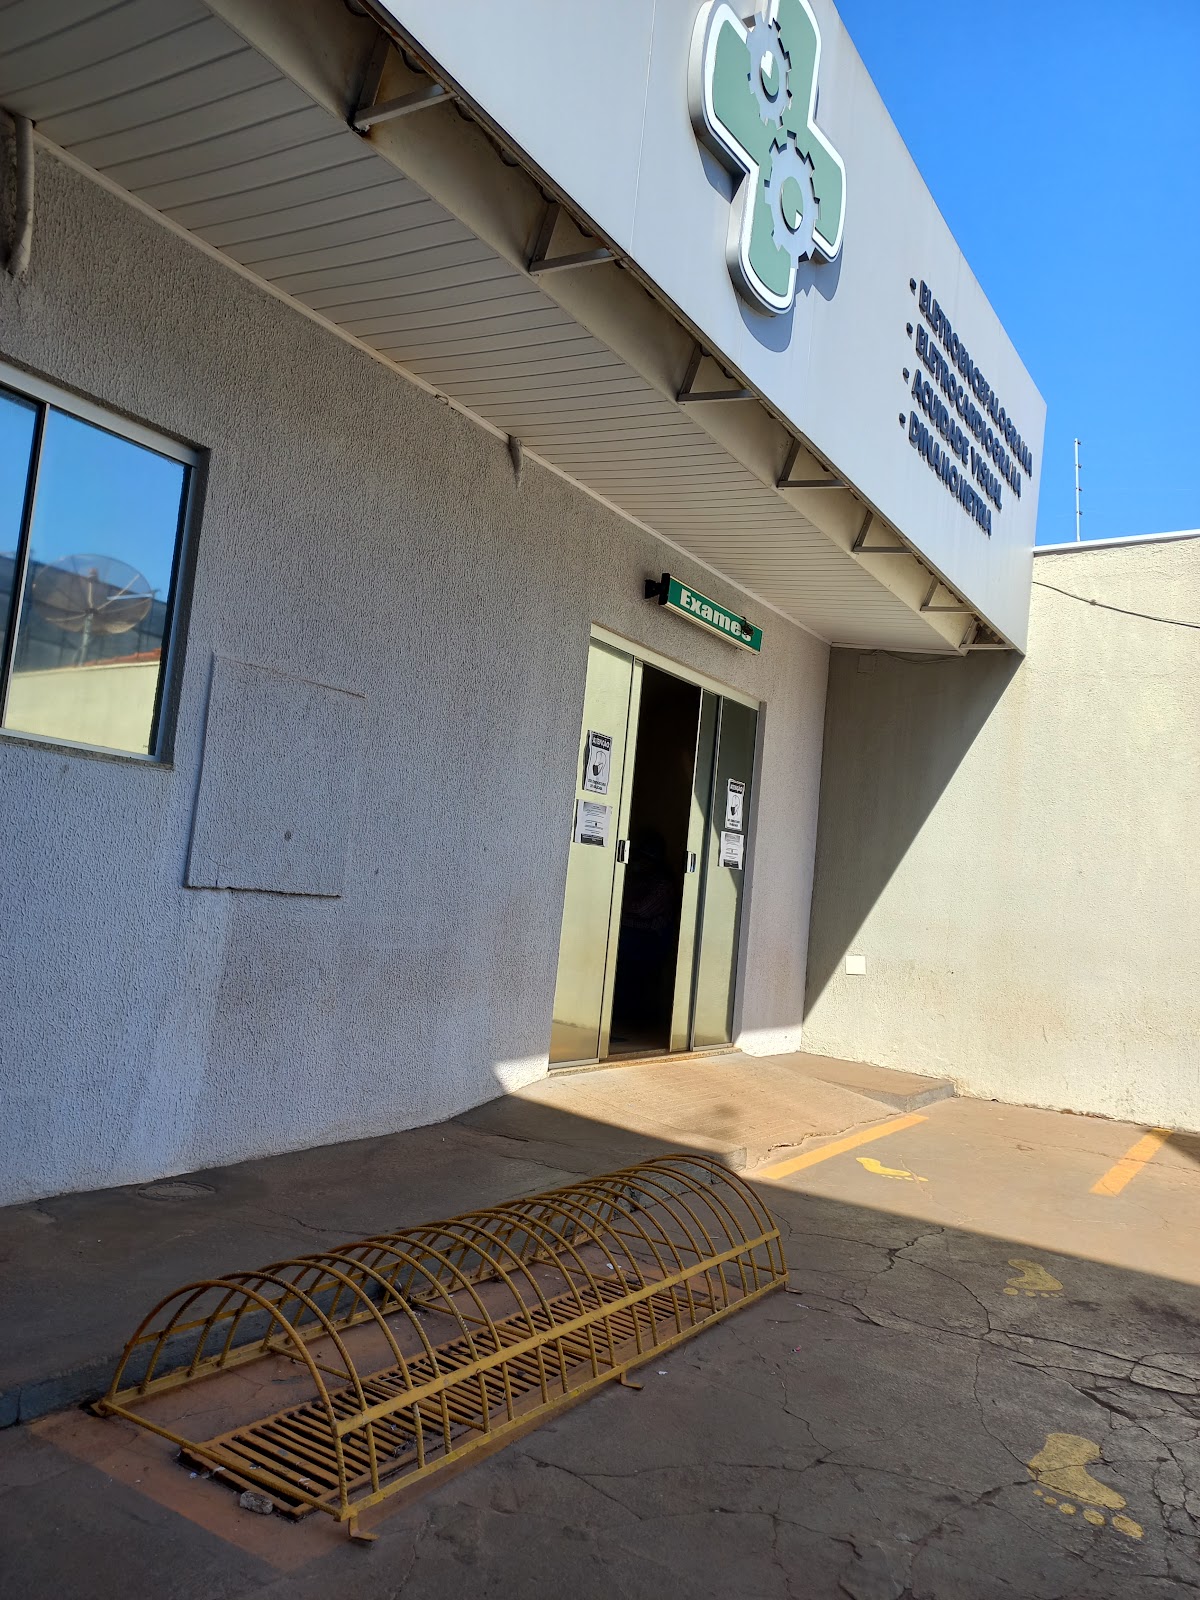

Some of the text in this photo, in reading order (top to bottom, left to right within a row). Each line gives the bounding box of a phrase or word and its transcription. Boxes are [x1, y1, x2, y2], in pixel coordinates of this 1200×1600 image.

[911, 368, 1003, 513] ACUIDADE VISUAL
[915, 323, 1021, 499] ELETROCARDIOGRAMA
[918, 280, 1032, 480] ELETROENCEFALOGRAMA
[908, 410, 992, 538] DINAMOMETRIA
